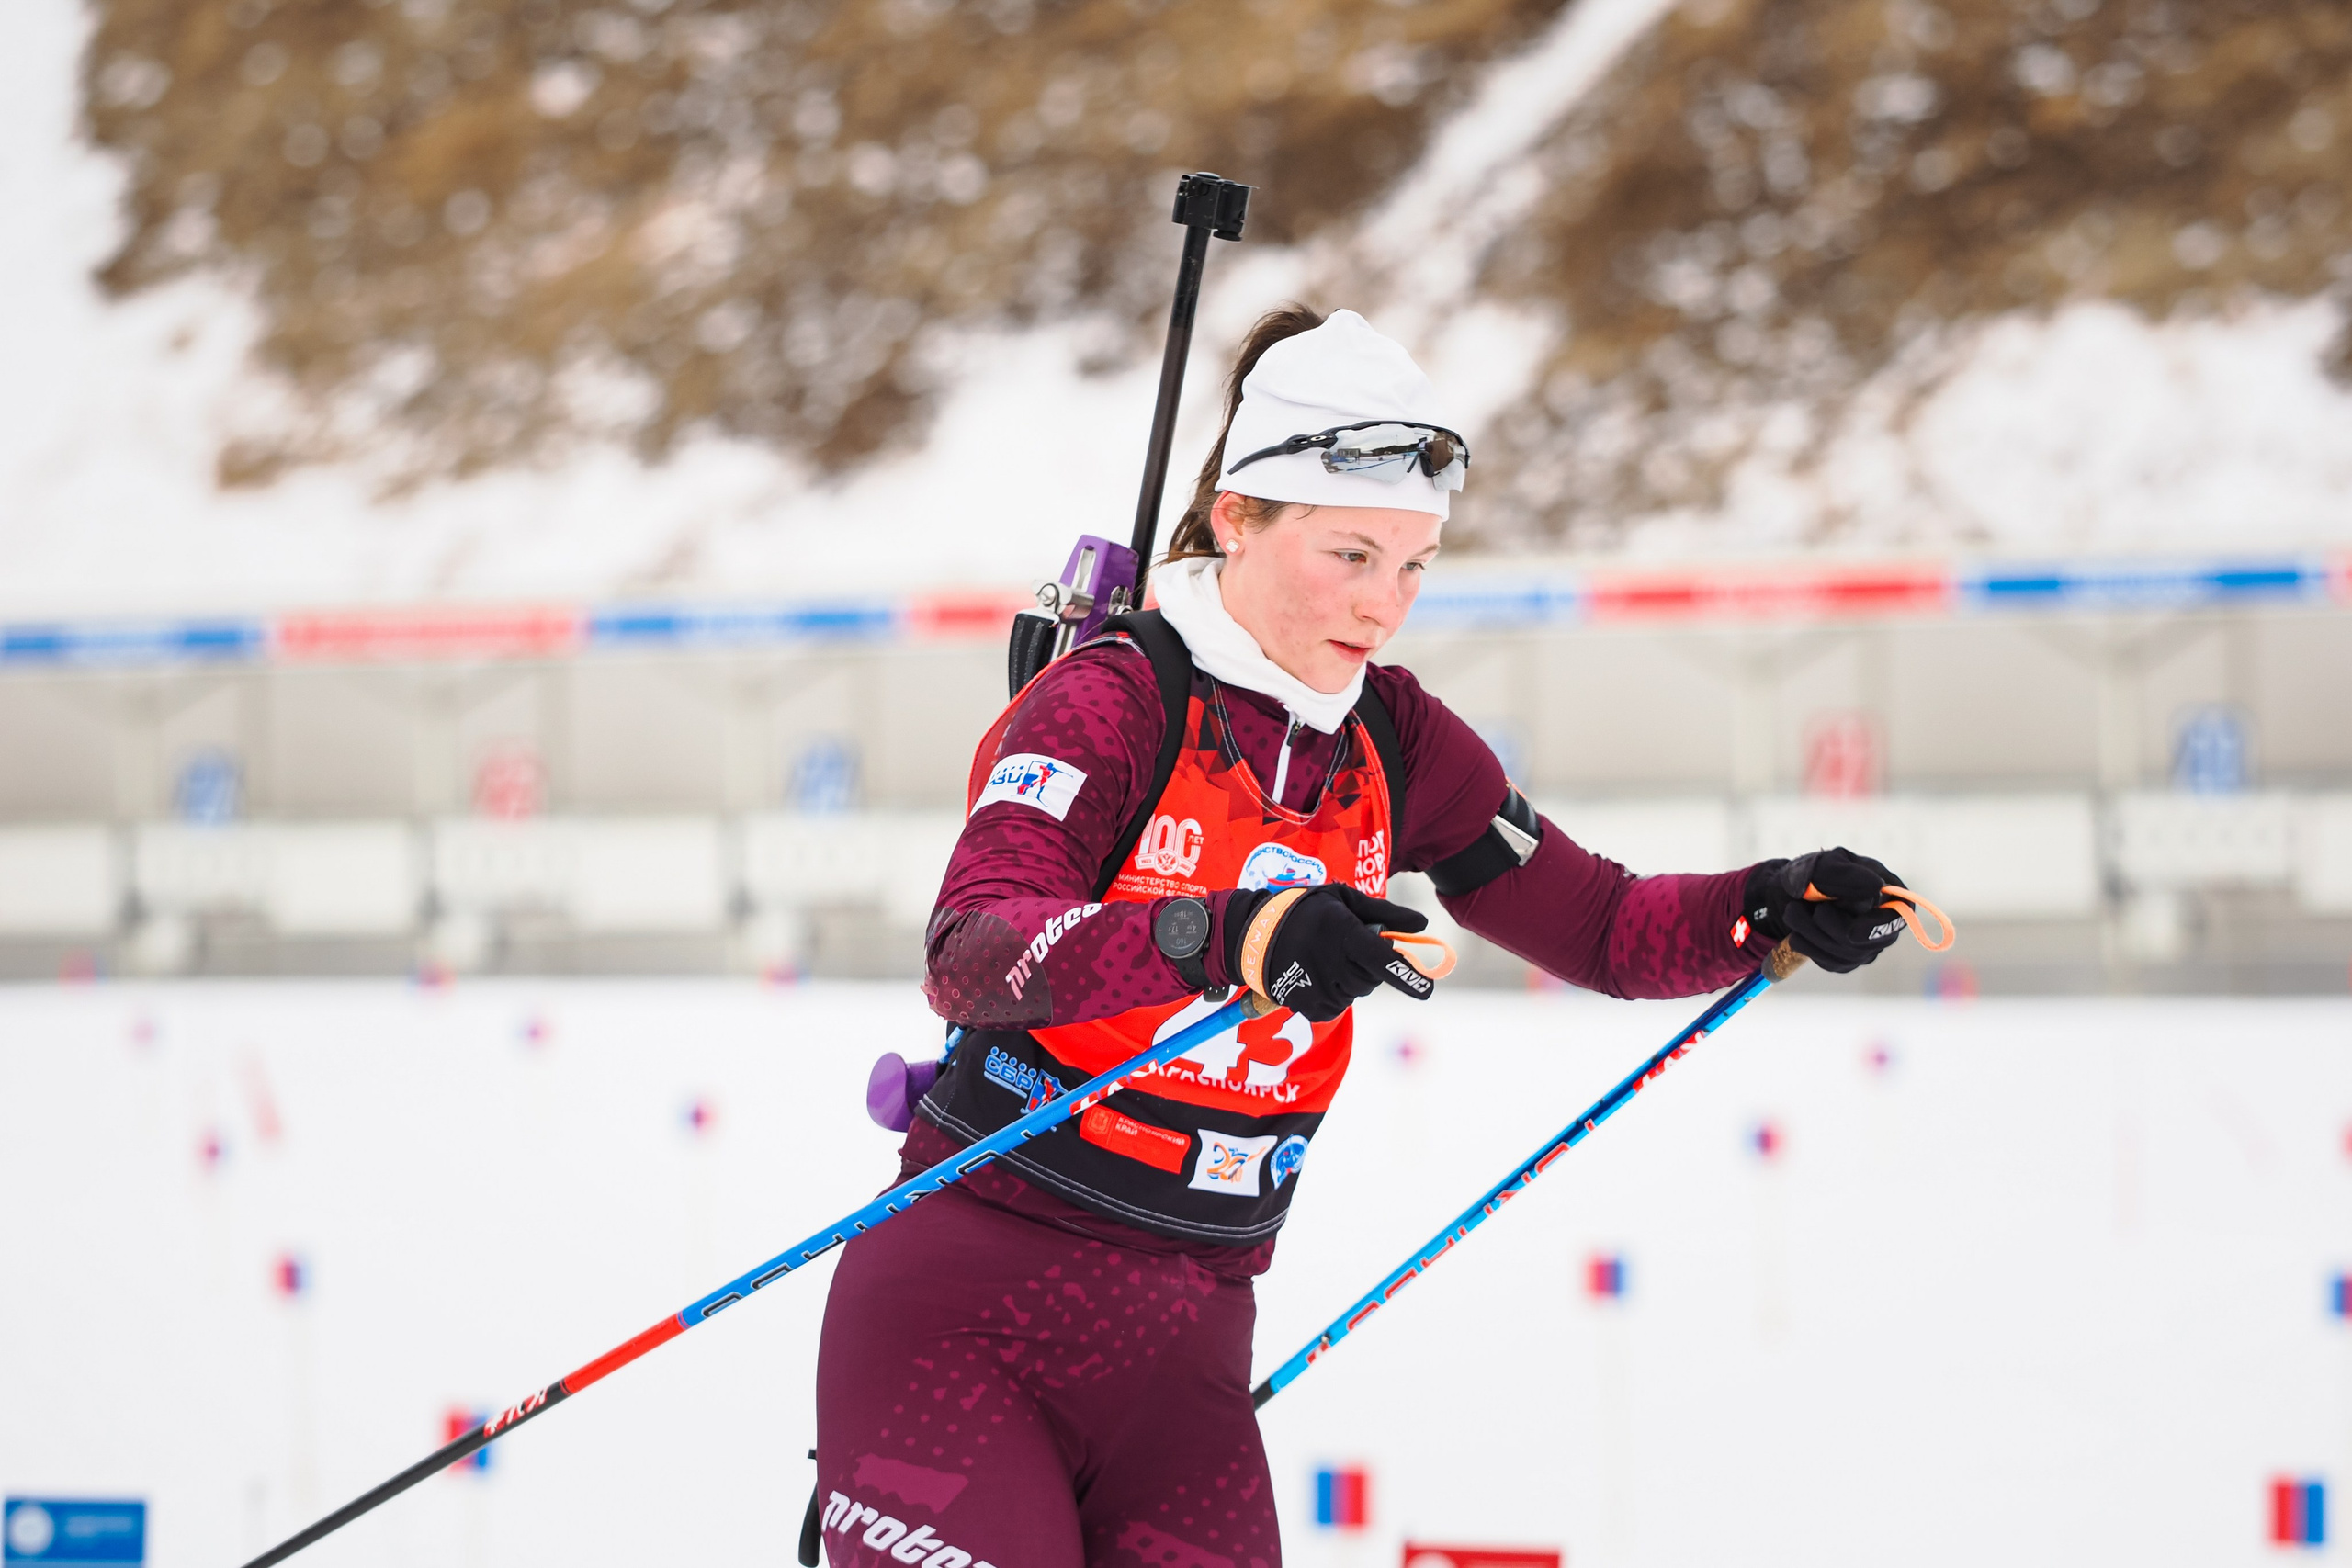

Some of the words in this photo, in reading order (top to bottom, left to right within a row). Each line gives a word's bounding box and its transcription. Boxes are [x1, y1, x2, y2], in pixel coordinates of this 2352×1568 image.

[1187, 835, 1204, 844] ЛЕТ
[1113, 882, 1165, 896] РОССИЙСКОЙ
[1118, 874, 1180, 890] МИНИСТЕРСТВО
[1181, 883, 1208, 895] СПОРТА
[1005, 902, 1109, 1001] protea
[1115, 1122, 1138, 1136] КРАЙ
[821, 1489, 998, 1568] prote
